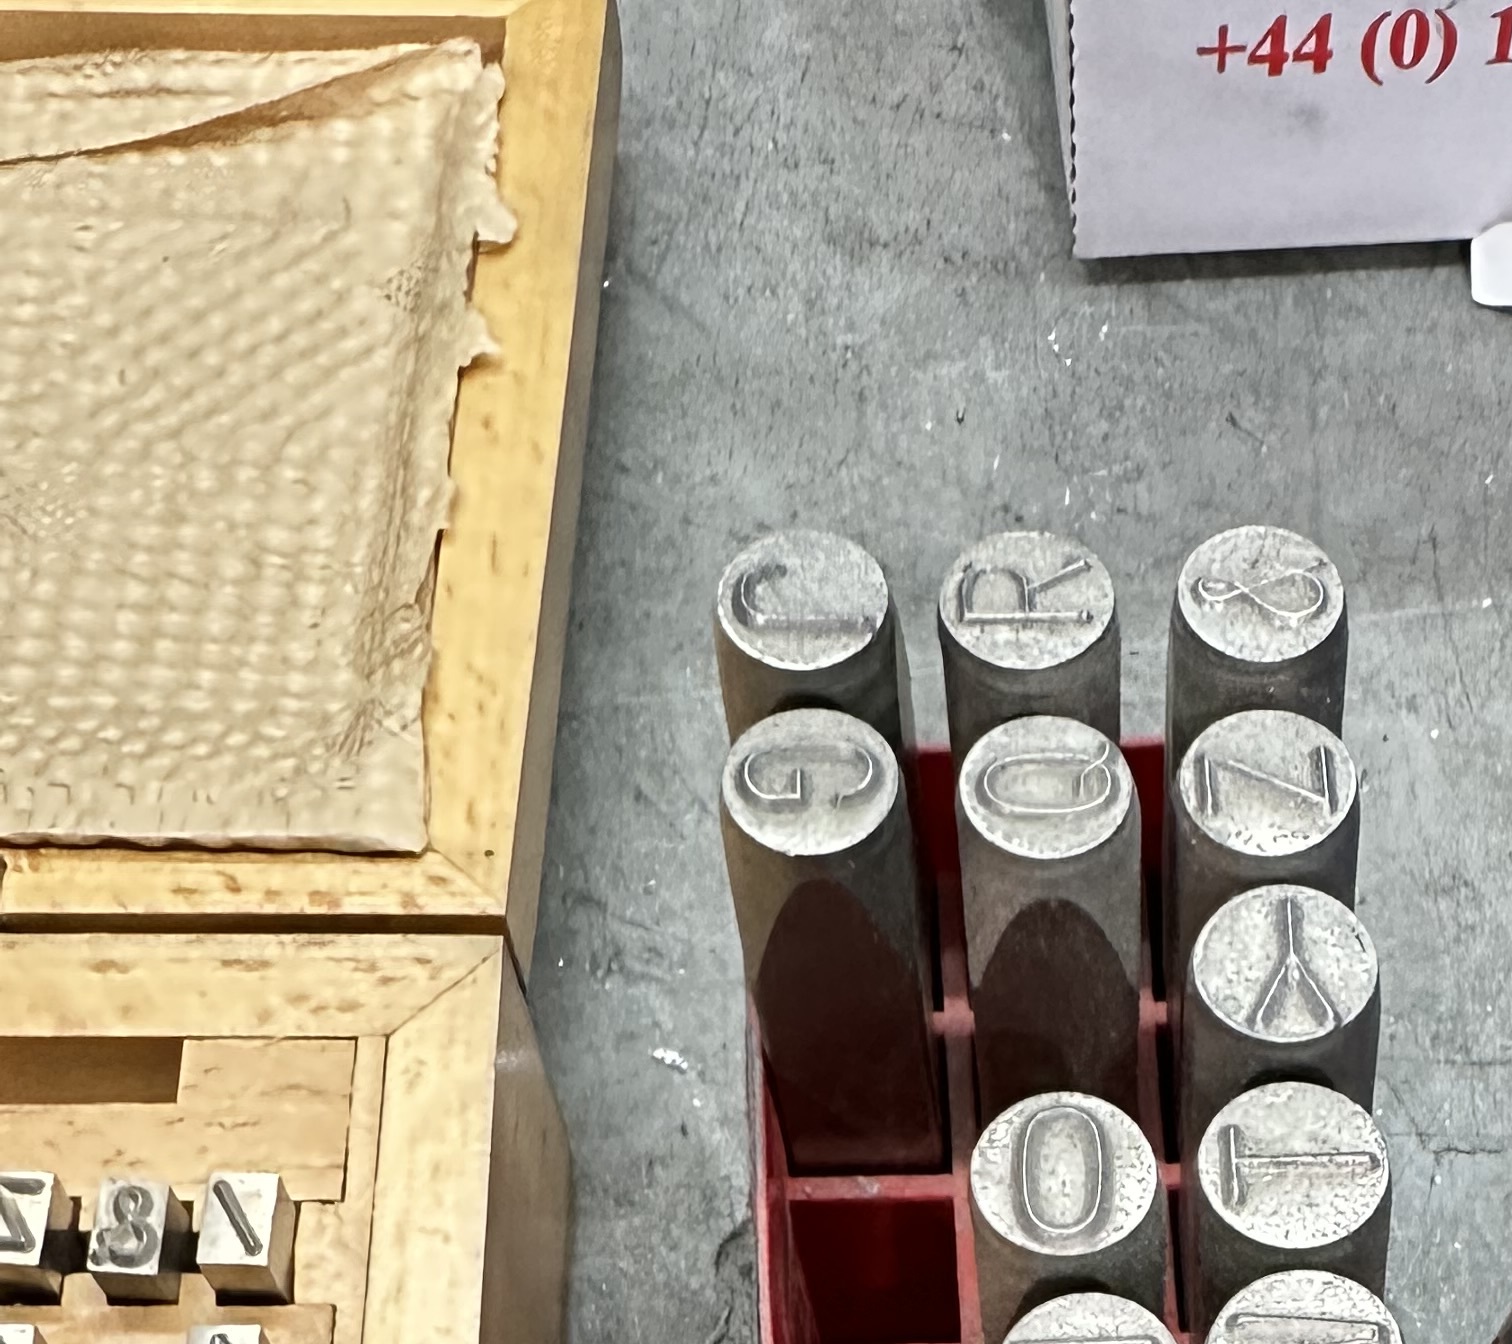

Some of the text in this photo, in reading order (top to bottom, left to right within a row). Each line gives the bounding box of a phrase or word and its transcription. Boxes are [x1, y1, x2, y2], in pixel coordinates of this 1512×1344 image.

[1196, 12, 1333, 77] +44
[1360, 9, 1458, 87] (0)
[961, 558, 1093, 624] R
